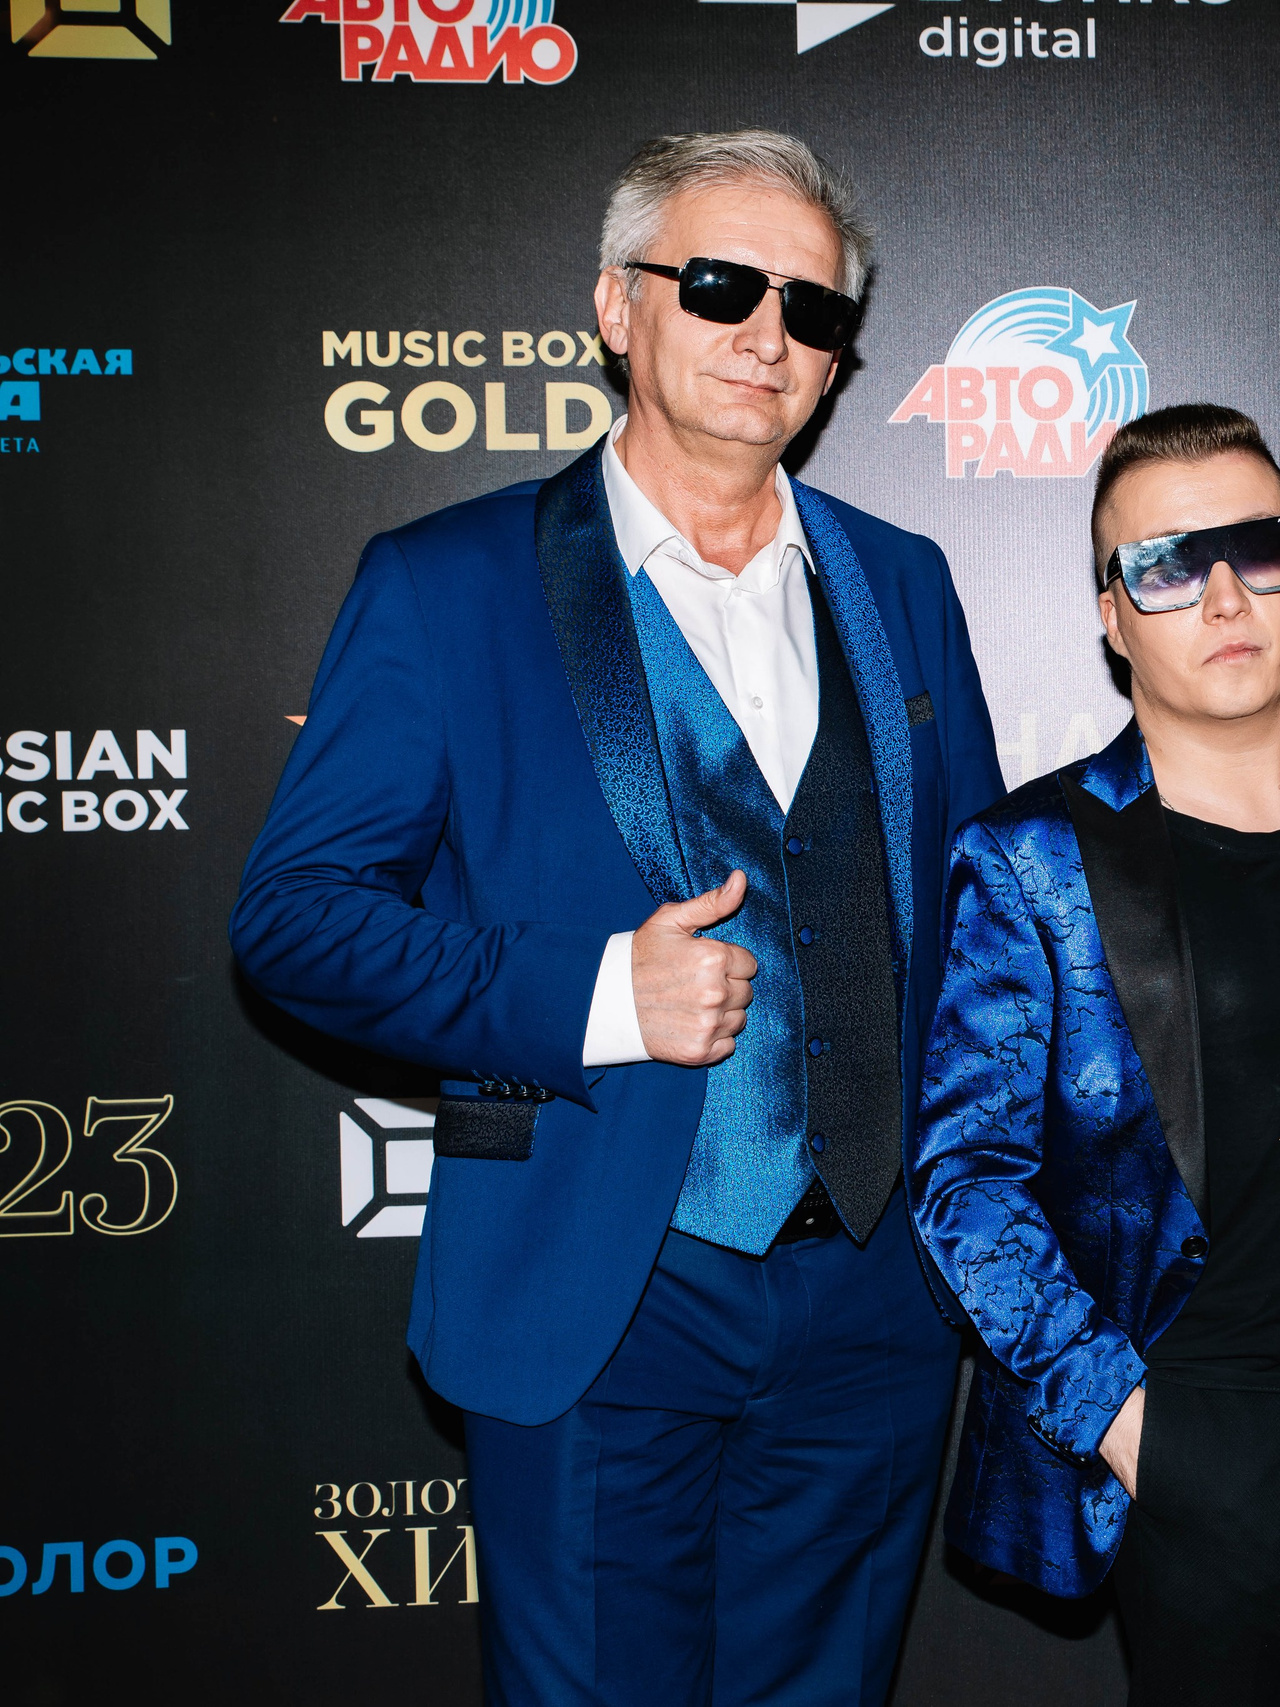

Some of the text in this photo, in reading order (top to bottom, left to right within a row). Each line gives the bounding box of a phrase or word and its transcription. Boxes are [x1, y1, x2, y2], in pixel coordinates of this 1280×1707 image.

[341, 23, 577, 84] РАДИО
[918, 16, 1097, 68] digital
[322, 330, 609, 367] MUSIC BOX
[323, 380, 613, 453] GOLD
[889, 365, 1075, 422] АВТО
[946, 421, 1119, 478] РАДИ
[0, 729, 188, 782] SIAN
[61, 789, 191, 832] BOX
[0, 1094, 179, 1237] 23
